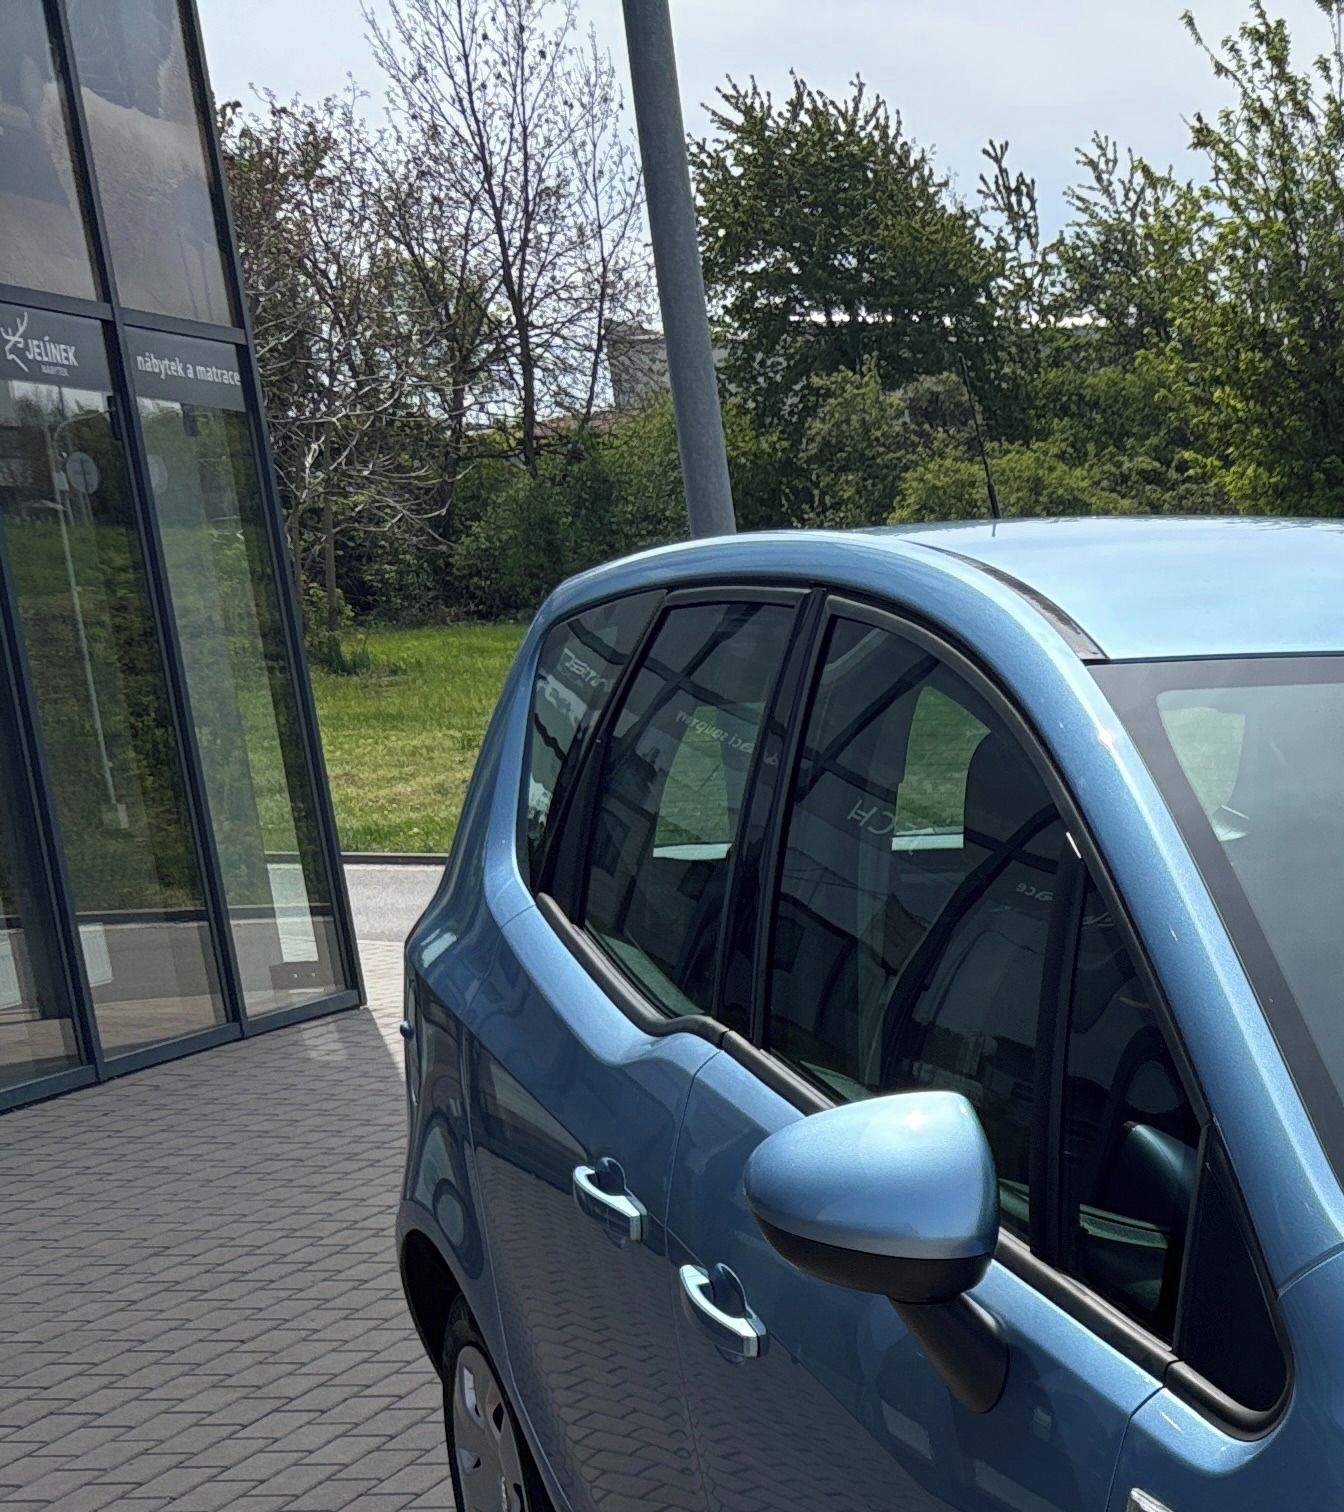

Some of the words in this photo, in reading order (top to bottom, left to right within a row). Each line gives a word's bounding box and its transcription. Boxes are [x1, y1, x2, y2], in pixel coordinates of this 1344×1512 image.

[25, 335, 79, 367] JELÍNEK
[136, 353, 185, 379] nábytek
[186, 363, 193, 378] a
[197, 365, 240, 386] matrace
